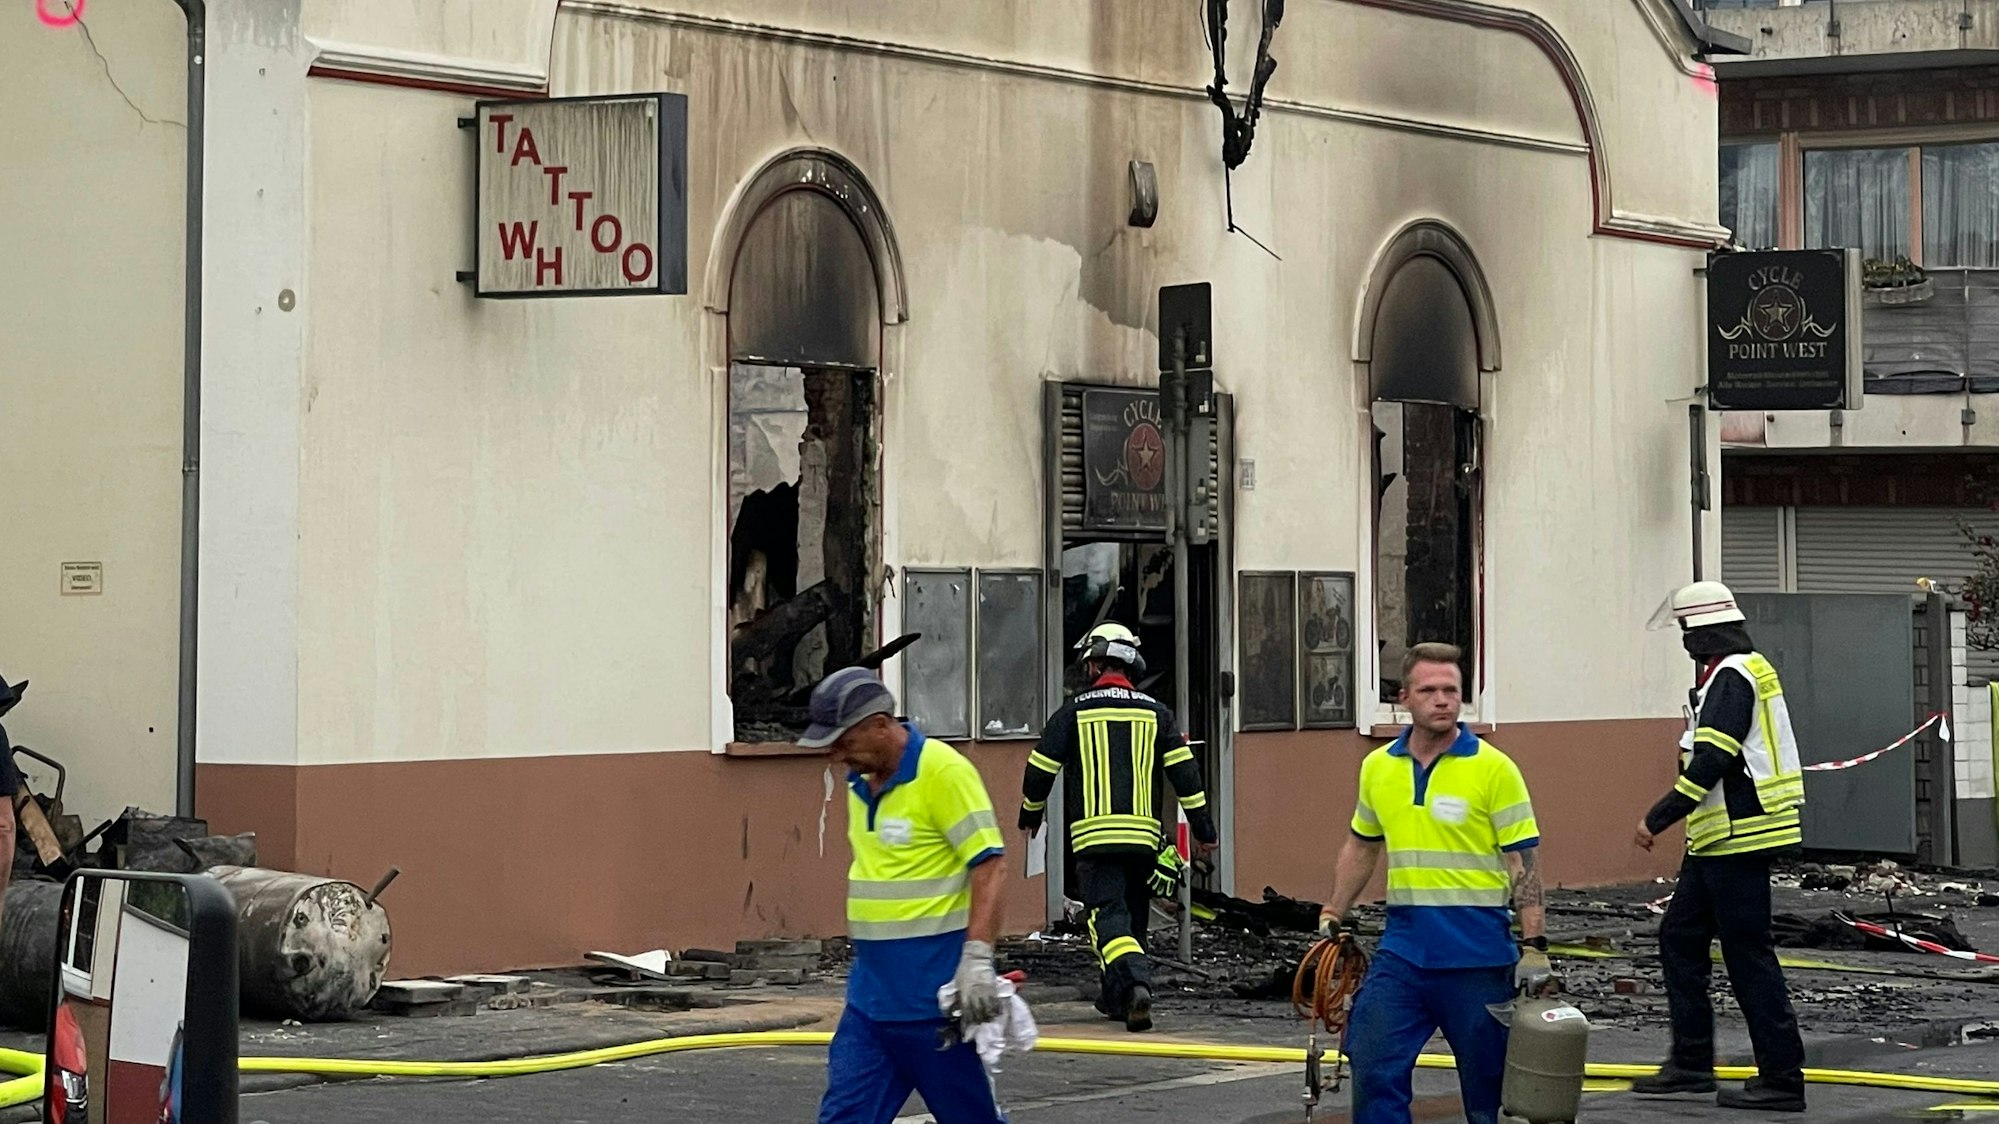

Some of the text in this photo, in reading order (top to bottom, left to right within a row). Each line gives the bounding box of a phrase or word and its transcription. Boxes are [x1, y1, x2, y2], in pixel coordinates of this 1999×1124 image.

[489, 114, 653, 282] TATTOO
[1748, 265, 1804, 291] CYCLE
[1728, 341, 1828, 360] POINT WEST
[1111, 491, 1148, 511] POINT
[1074, 686, 1131, 704] FEUERWEHR
